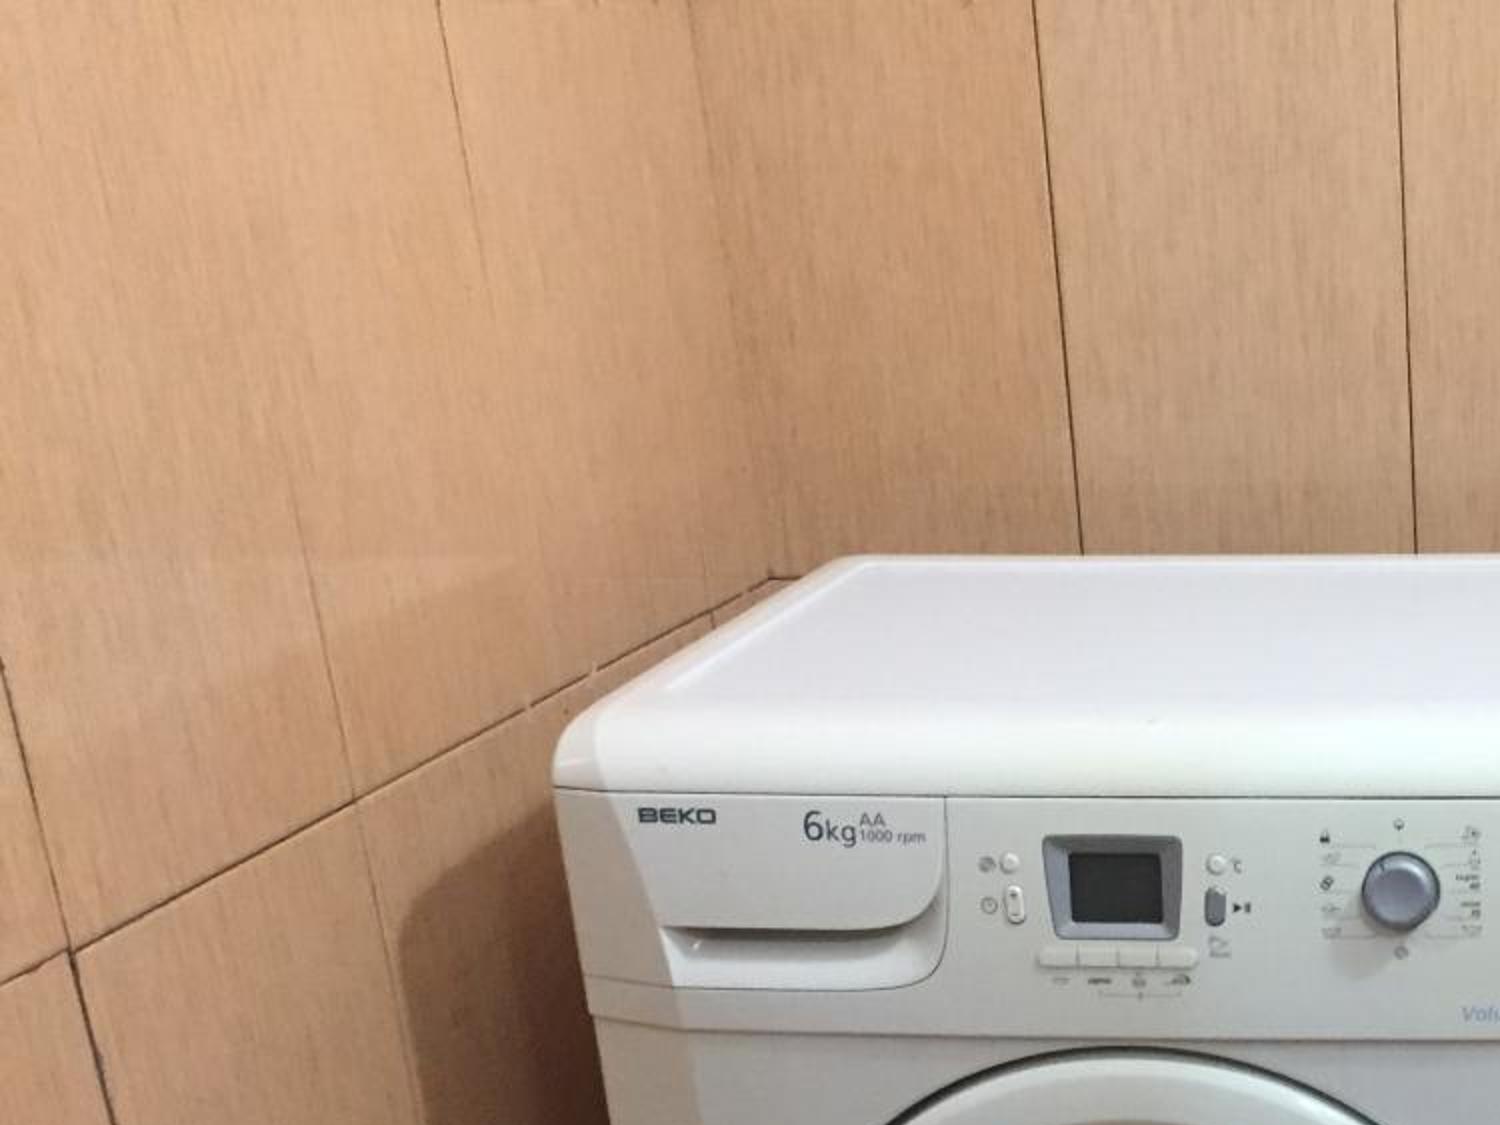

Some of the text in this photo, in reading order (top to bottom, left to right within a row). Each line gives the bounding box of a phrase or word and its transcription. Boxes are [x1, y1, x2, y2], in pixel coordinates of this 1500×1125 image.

[638, 807, 717, 825] BEKO
[860, 812, 886, 827] AA
[803, 810, 857, 848] 6kg
[861, 829, 927, 846] 1000 rpm
